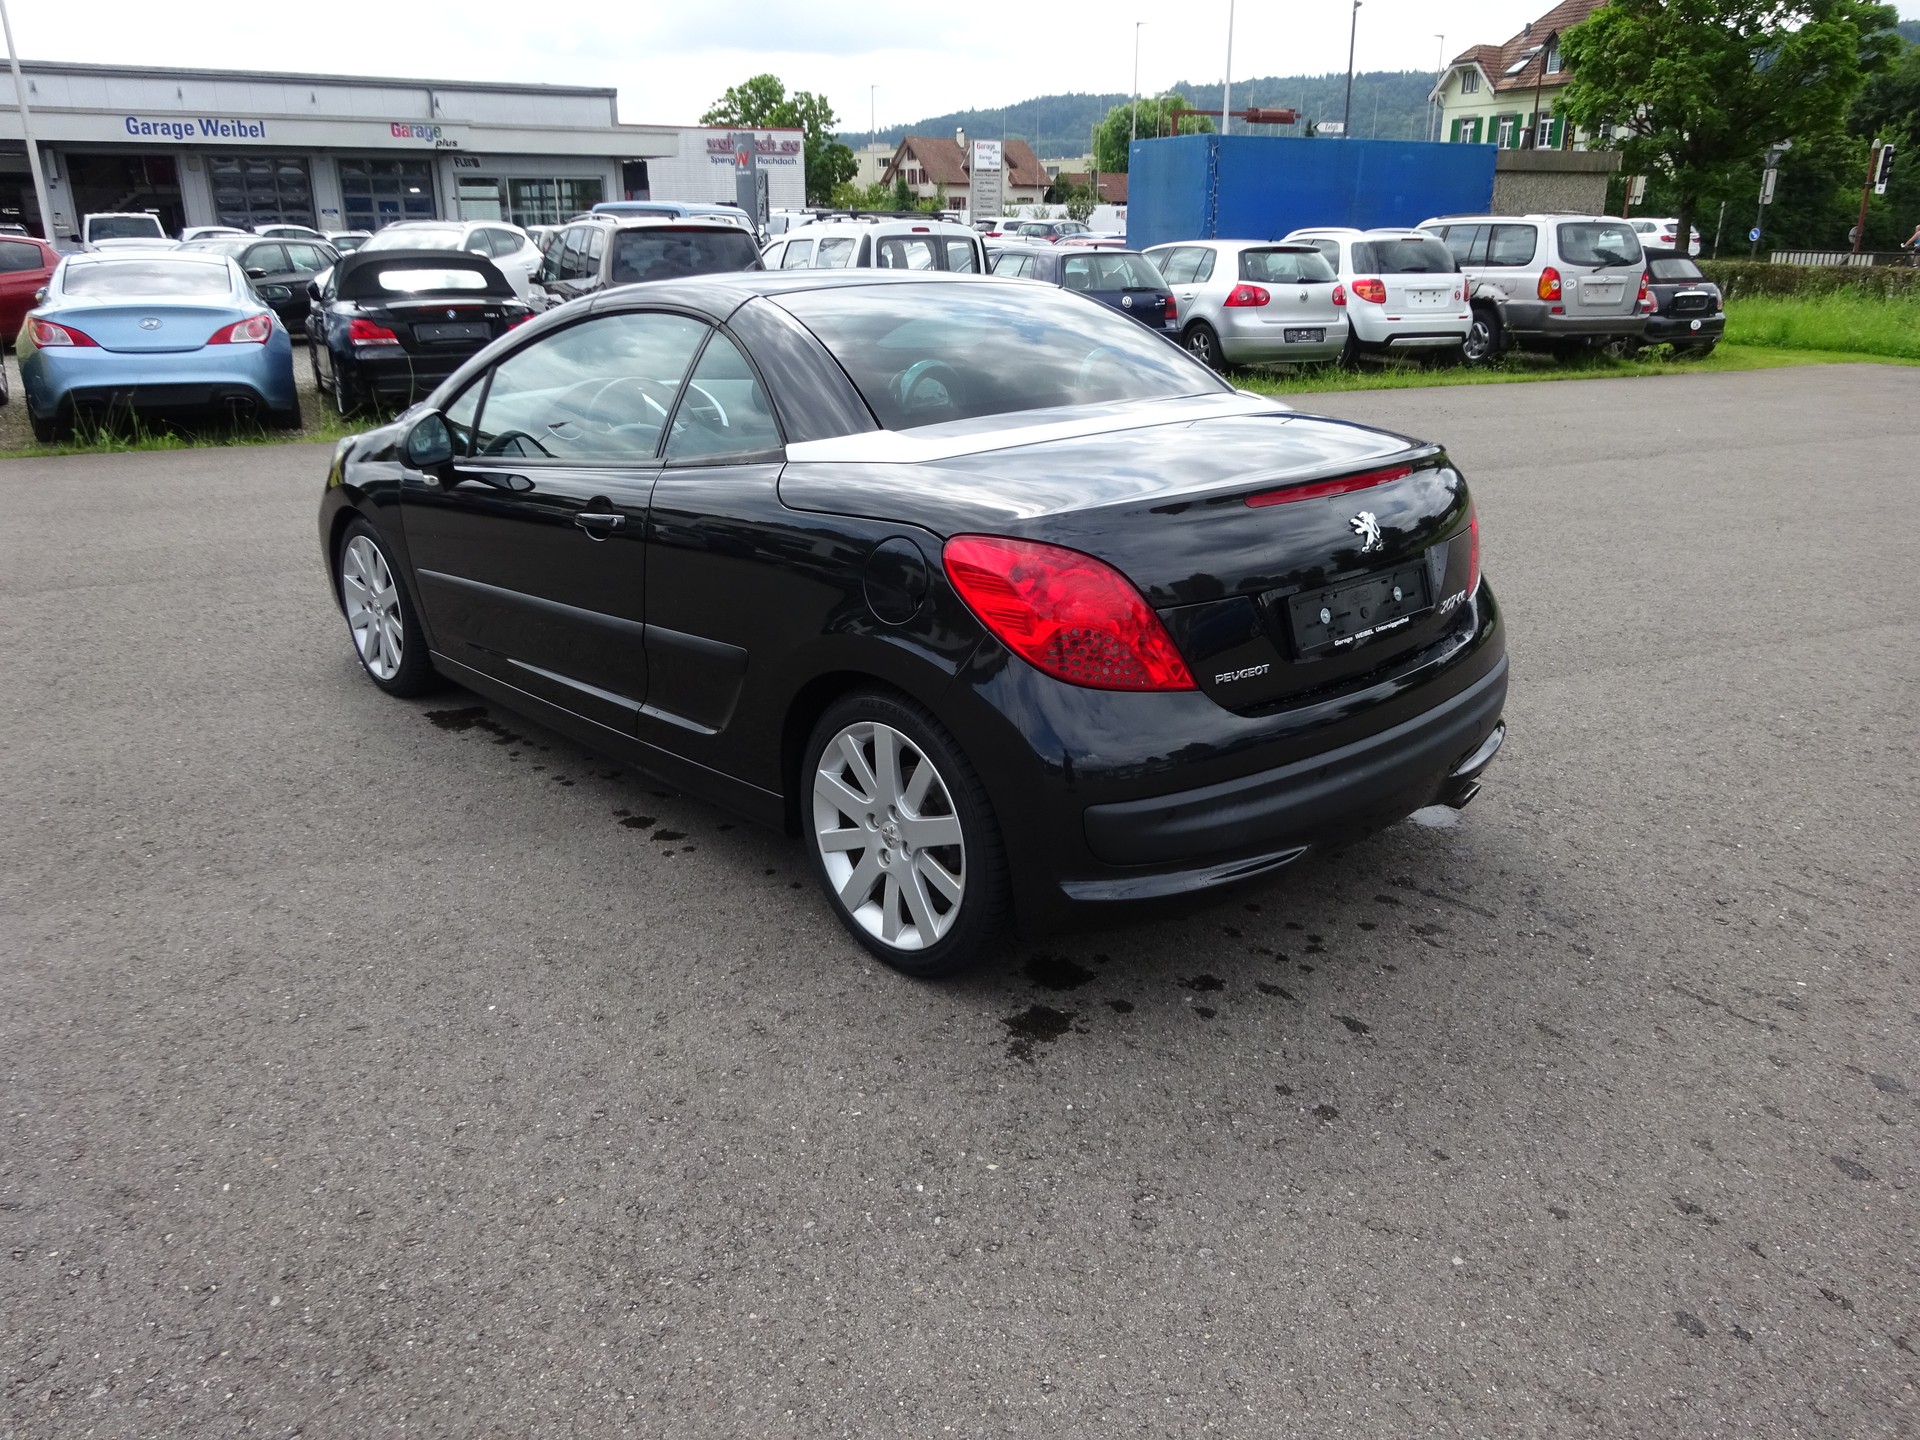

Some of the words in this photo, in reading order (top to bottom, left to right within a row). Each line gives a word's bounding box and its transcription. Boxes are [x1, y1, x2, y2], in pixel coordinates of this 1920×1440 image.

[125, 116, 195, 140] Garage
[198, 118, 266, 138] Weibel
[391, 122, 442, 142] Garage
[435, 139, 458, 149] plus
[976, 143, 995, 151] Garage
[1334, 637, 1353, 646] Garage
[1355, 629, 1374, 639] WEIBEL
[1215, 663, 1270, 685] PEUGEOT
